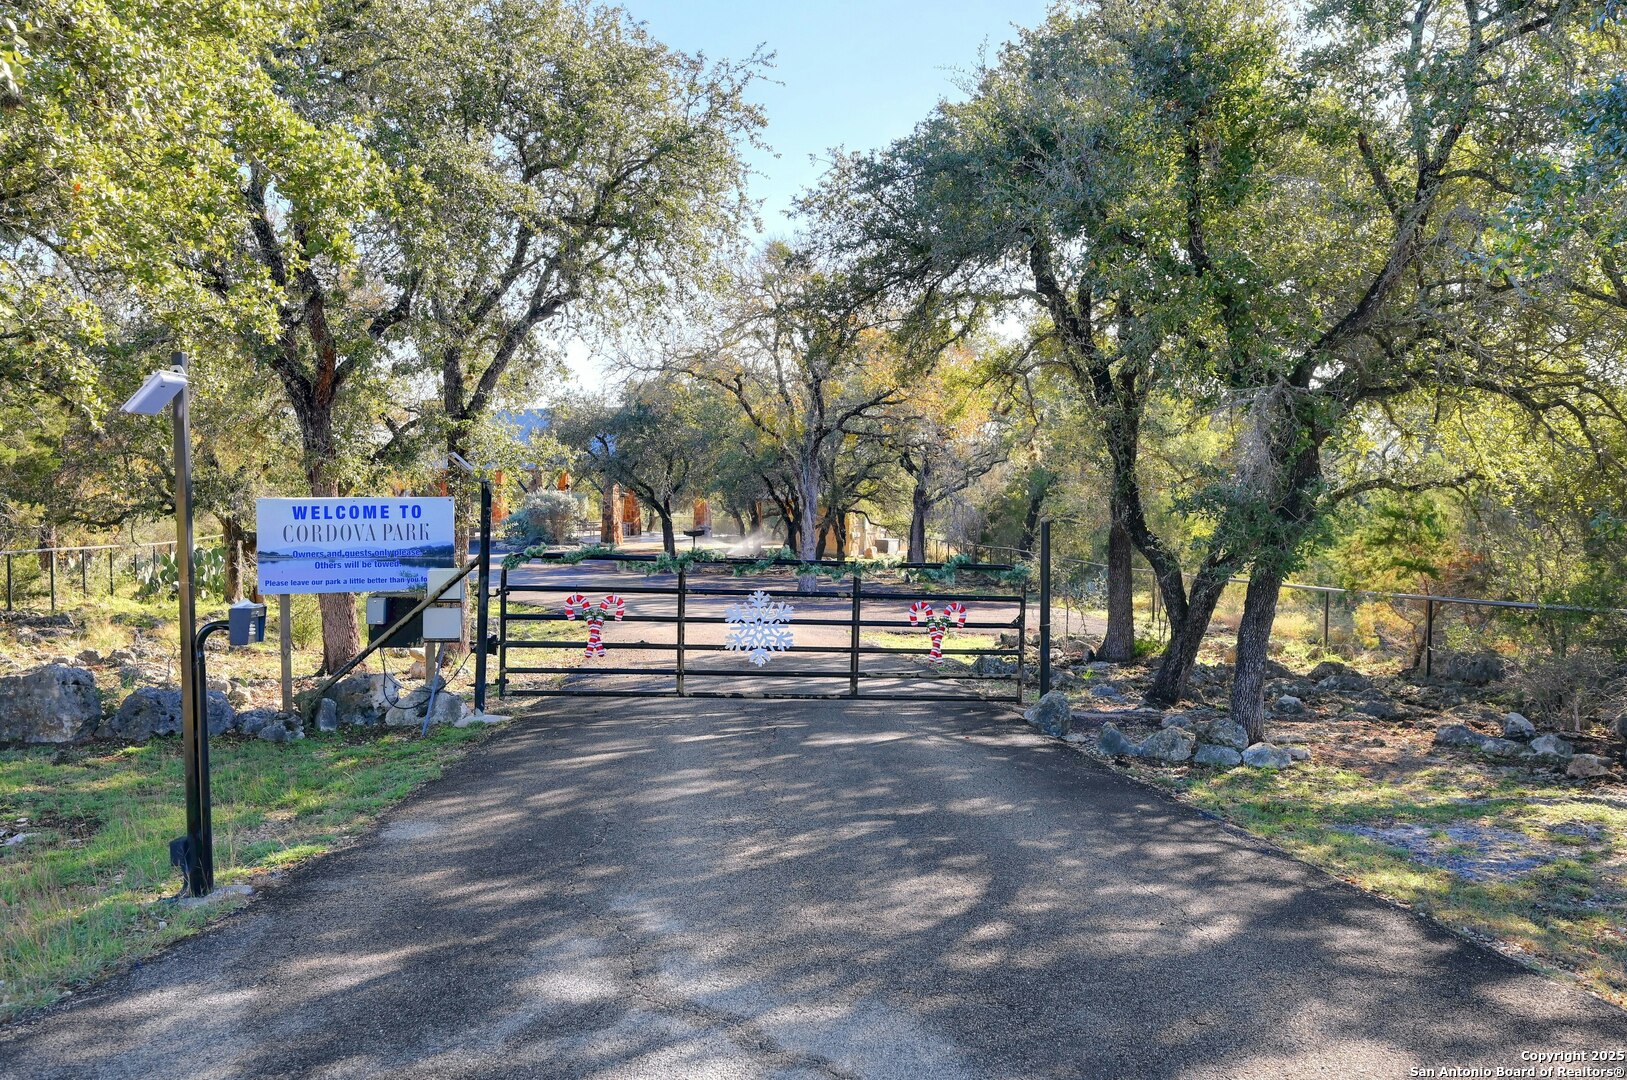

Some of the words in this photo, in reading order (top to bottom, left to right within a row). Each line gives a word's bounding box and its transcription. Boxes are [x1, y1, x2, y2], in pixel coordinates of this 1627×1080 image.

[292, 505, 389, 520] WELCOME
[399, 504, 421, 519] TO
[283, 523, 376, 543] CORDOVA
[383, 522, 430, 542] PARK
[293, 550, 324, 558] Owners
[327, 549, 342, 558] and
[345, 549, 372, 559] guests
[374, 549, 392, 559] only
[315, 561, 342, 569] Others
[344, 560, 359, 569] will
[362, 560, 372, 568] be
[374, 559, 402, 568] towed.
[265, 579, 288, 587] Please
[325, 578, 341, 586] park
[349, 577, 365, 585] little
